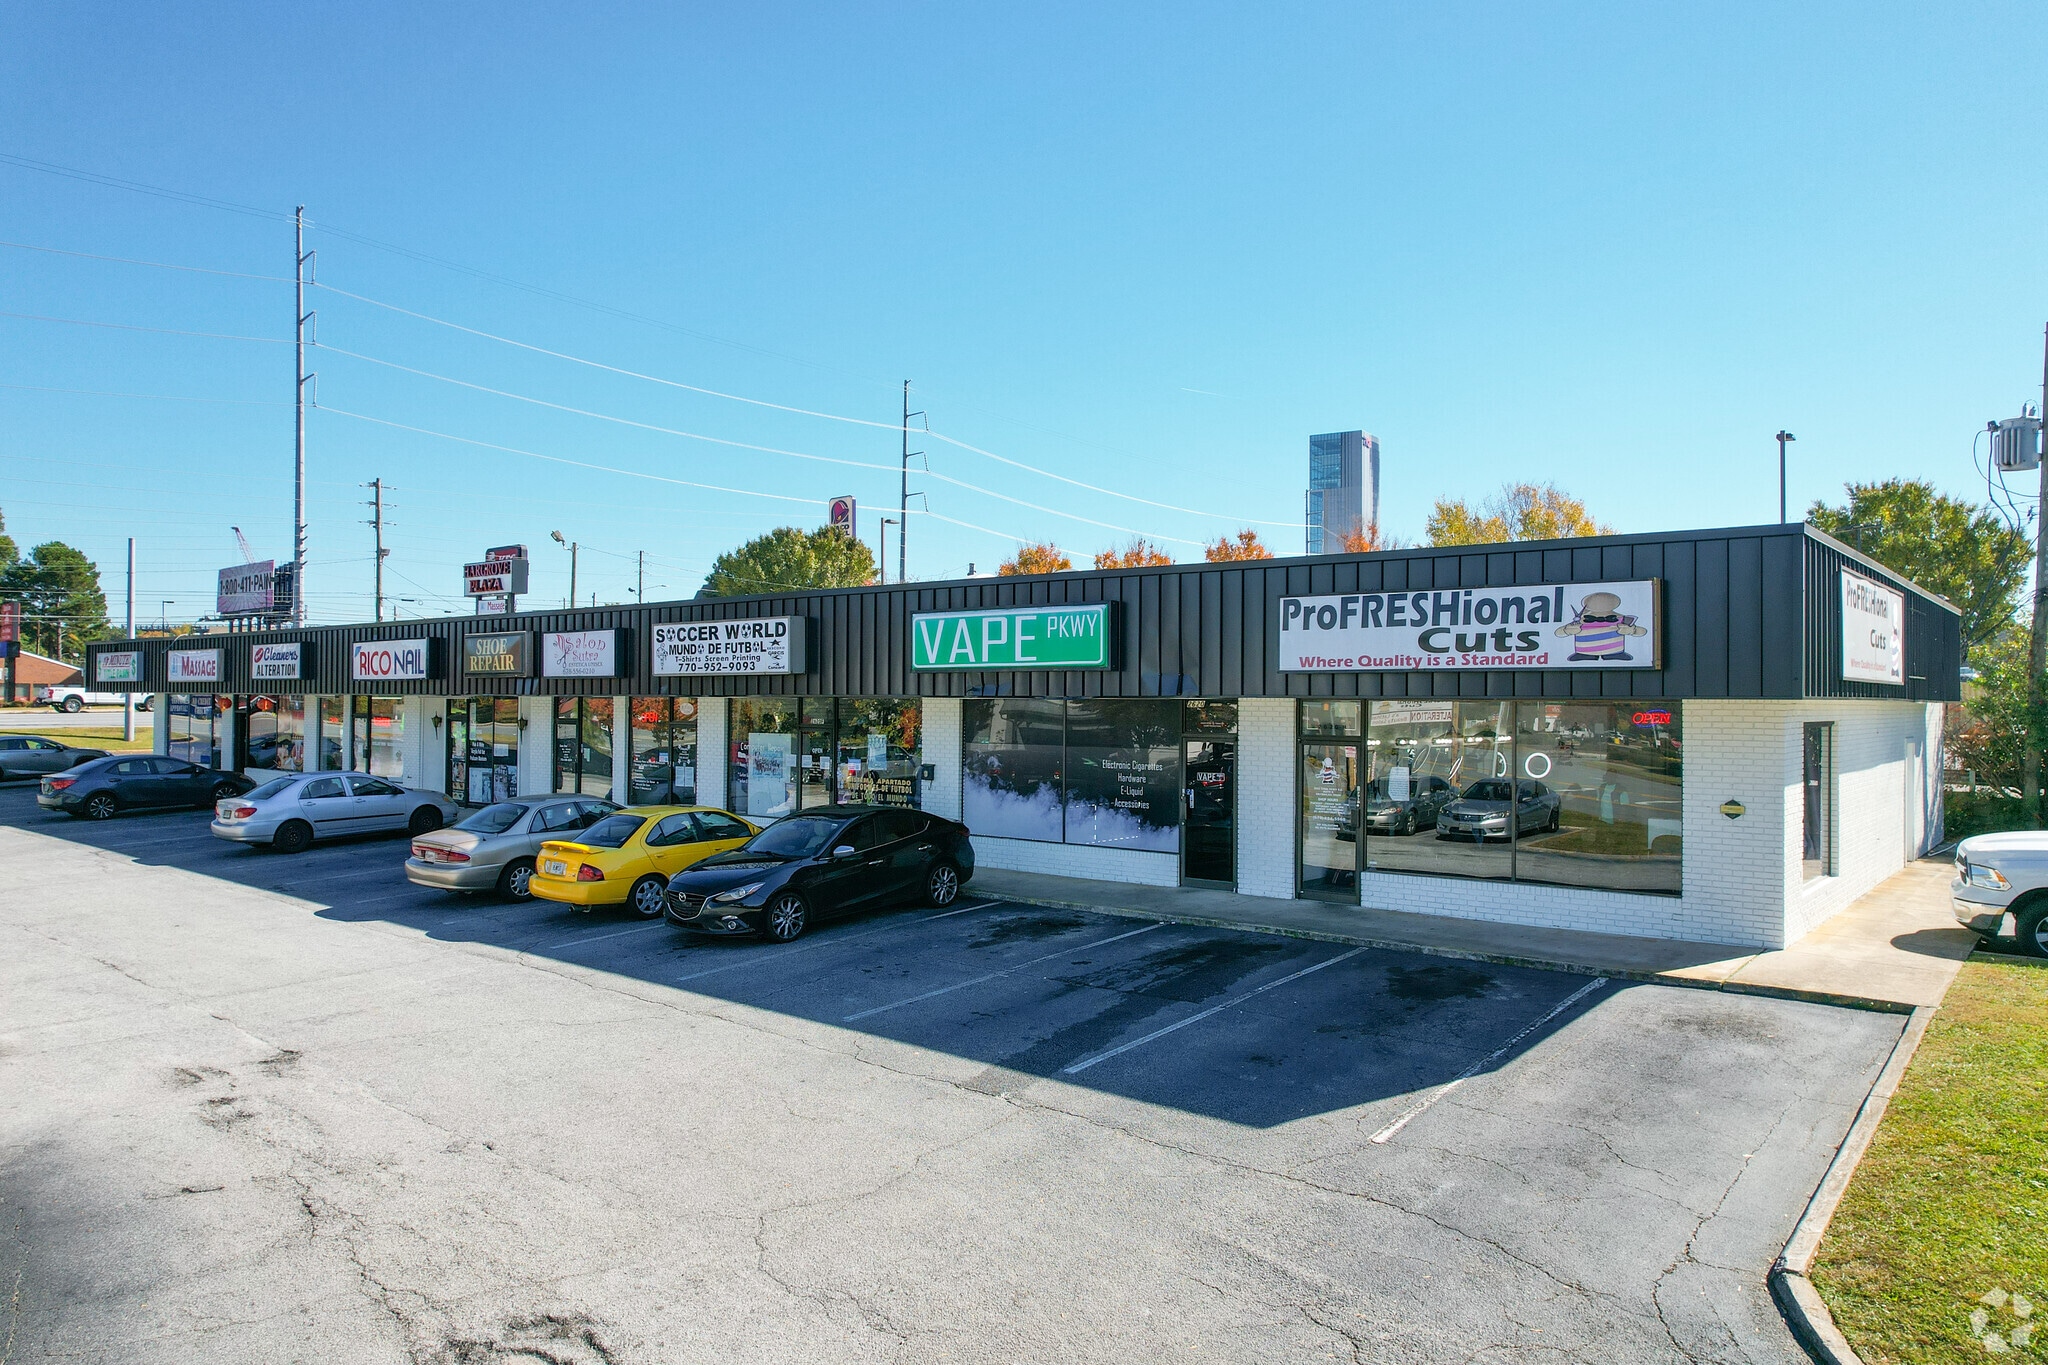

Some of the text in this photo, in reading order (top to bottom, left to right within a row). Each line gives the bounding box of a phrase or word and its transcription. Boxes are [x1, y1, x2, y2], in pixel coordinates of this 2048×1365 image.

[463, 561, 510, 578] HARGROVE
[220, 572, 272, 595] 1-800-411-PAIN
[470, 578, 503, 593] PLAZA
[1282, 586, 1565, 631] ProFRESHional
[655, 621, 787, 643] SOCCER WORLD
[919, 613, 1098, 664] VAPE PKWY
[1418, 626, 1540, 654] Cuts
[1870, 629, 1886, 650] Cuts
[263, 647, 298, 661] Cleaners
[475, 638, 507, 656] SHOE
[669, 641, 767, 655] MUNDO DE FUTBOL
[360, 649, 424, 676] RICO NAIL
[470, 654, 515, 671] REPAIR
[732, 654, 761, 662] Printing
[1299, 652, 1549, 670] Where Quality is a Standard
[256, 663, 296, 677] ALTERATION
[678, 662, 756, 672] 770-952-9093
[1632, 711, 1672, 725] OPEN
[1102, 759, 1163, 772] Electronic Cigarettes
[877, 778, 912, 786] APARTADO
[1117, 772, 1147, 783] Hardware
[1197, 772, 1216, 781] VAPE
[891, 785, 912, 793] FUTBOL
[1120, 785, 1144, 797] E-Liquid
[1114, 797, 1150, 809] Accessories
